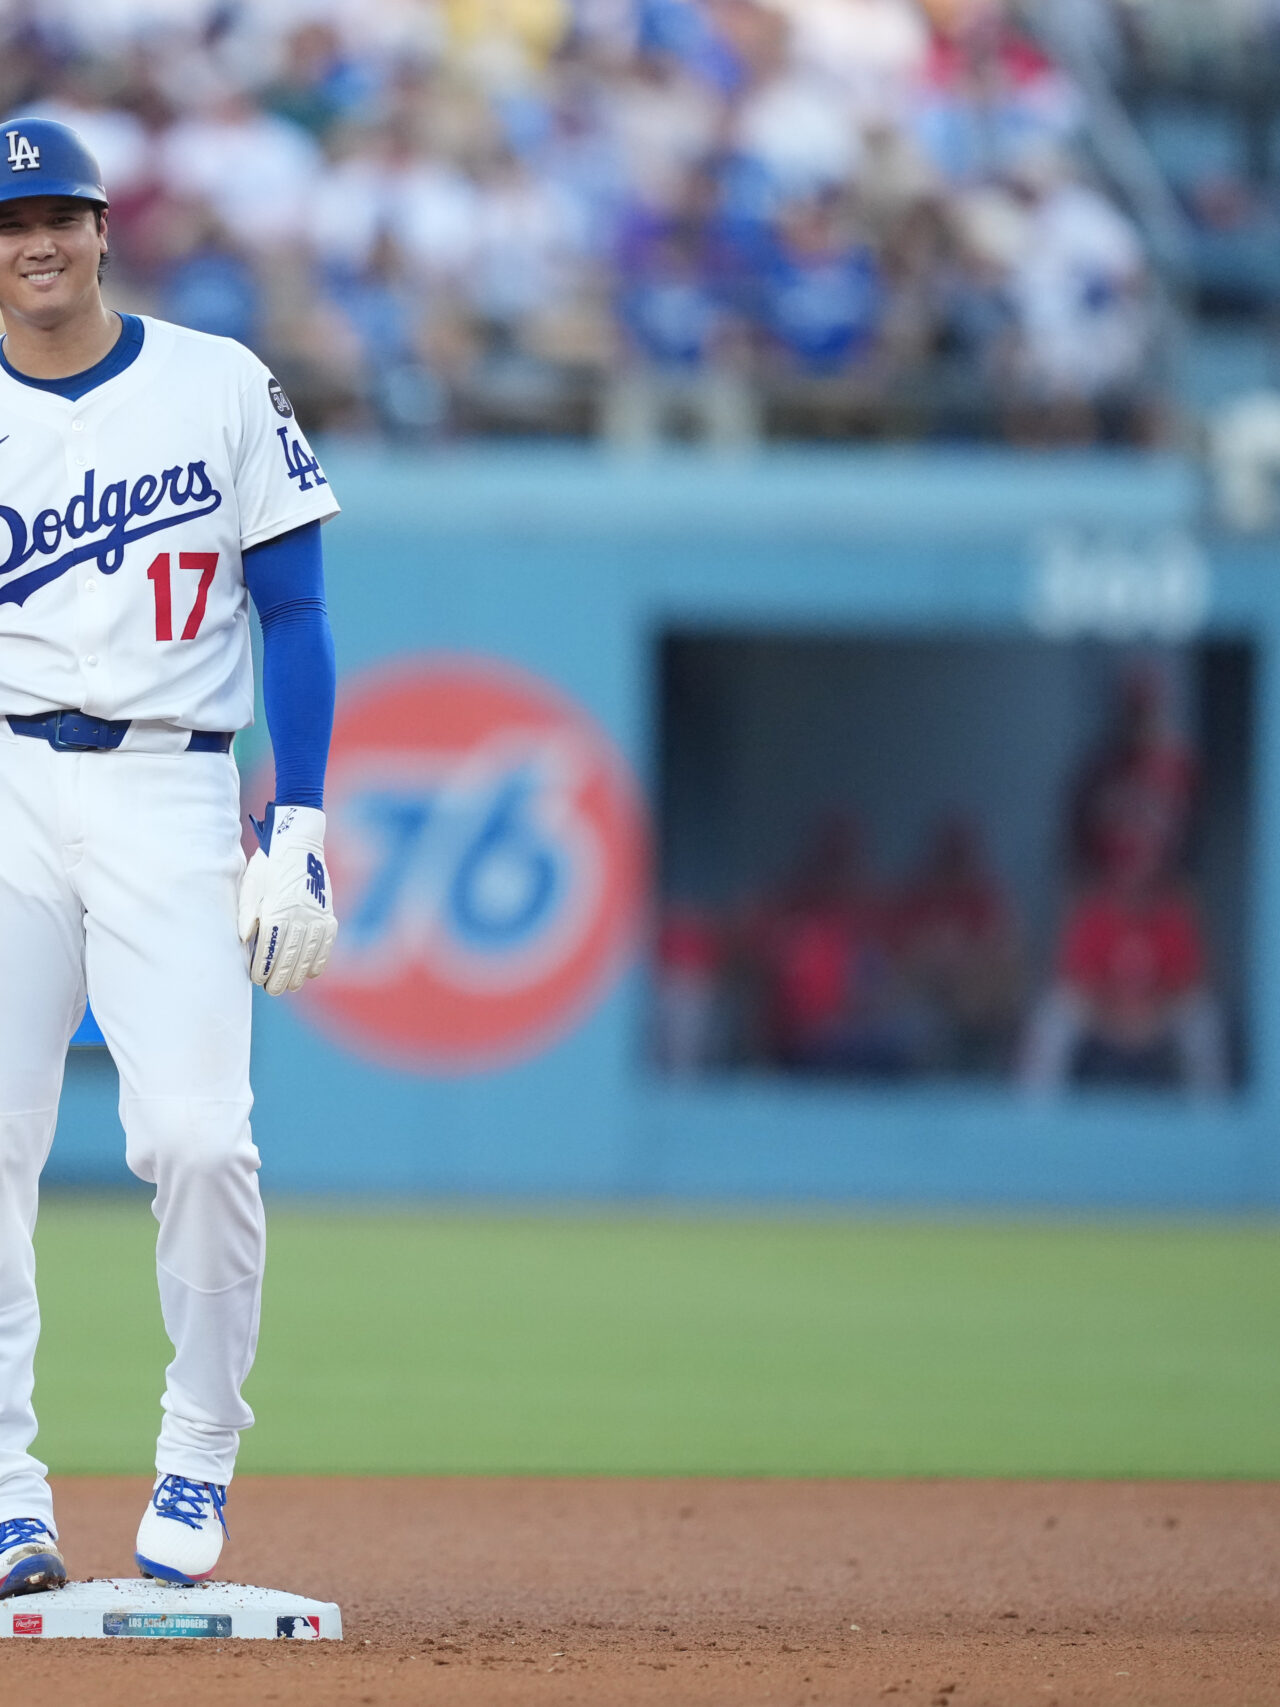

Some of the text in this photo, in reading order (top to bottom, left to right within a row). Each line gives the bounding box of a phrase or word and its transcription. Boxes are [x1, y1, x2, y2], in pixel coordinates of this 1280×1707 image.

[5, 130, 41, 172] LA
[276, 426, 327, 491] LA
[146, 551, 220, 642] 17
[340, 755, 565, 960] 76
[128, 1617, 143, 1628] LOS
[175, 1618, 209, 1629] DODGERS
